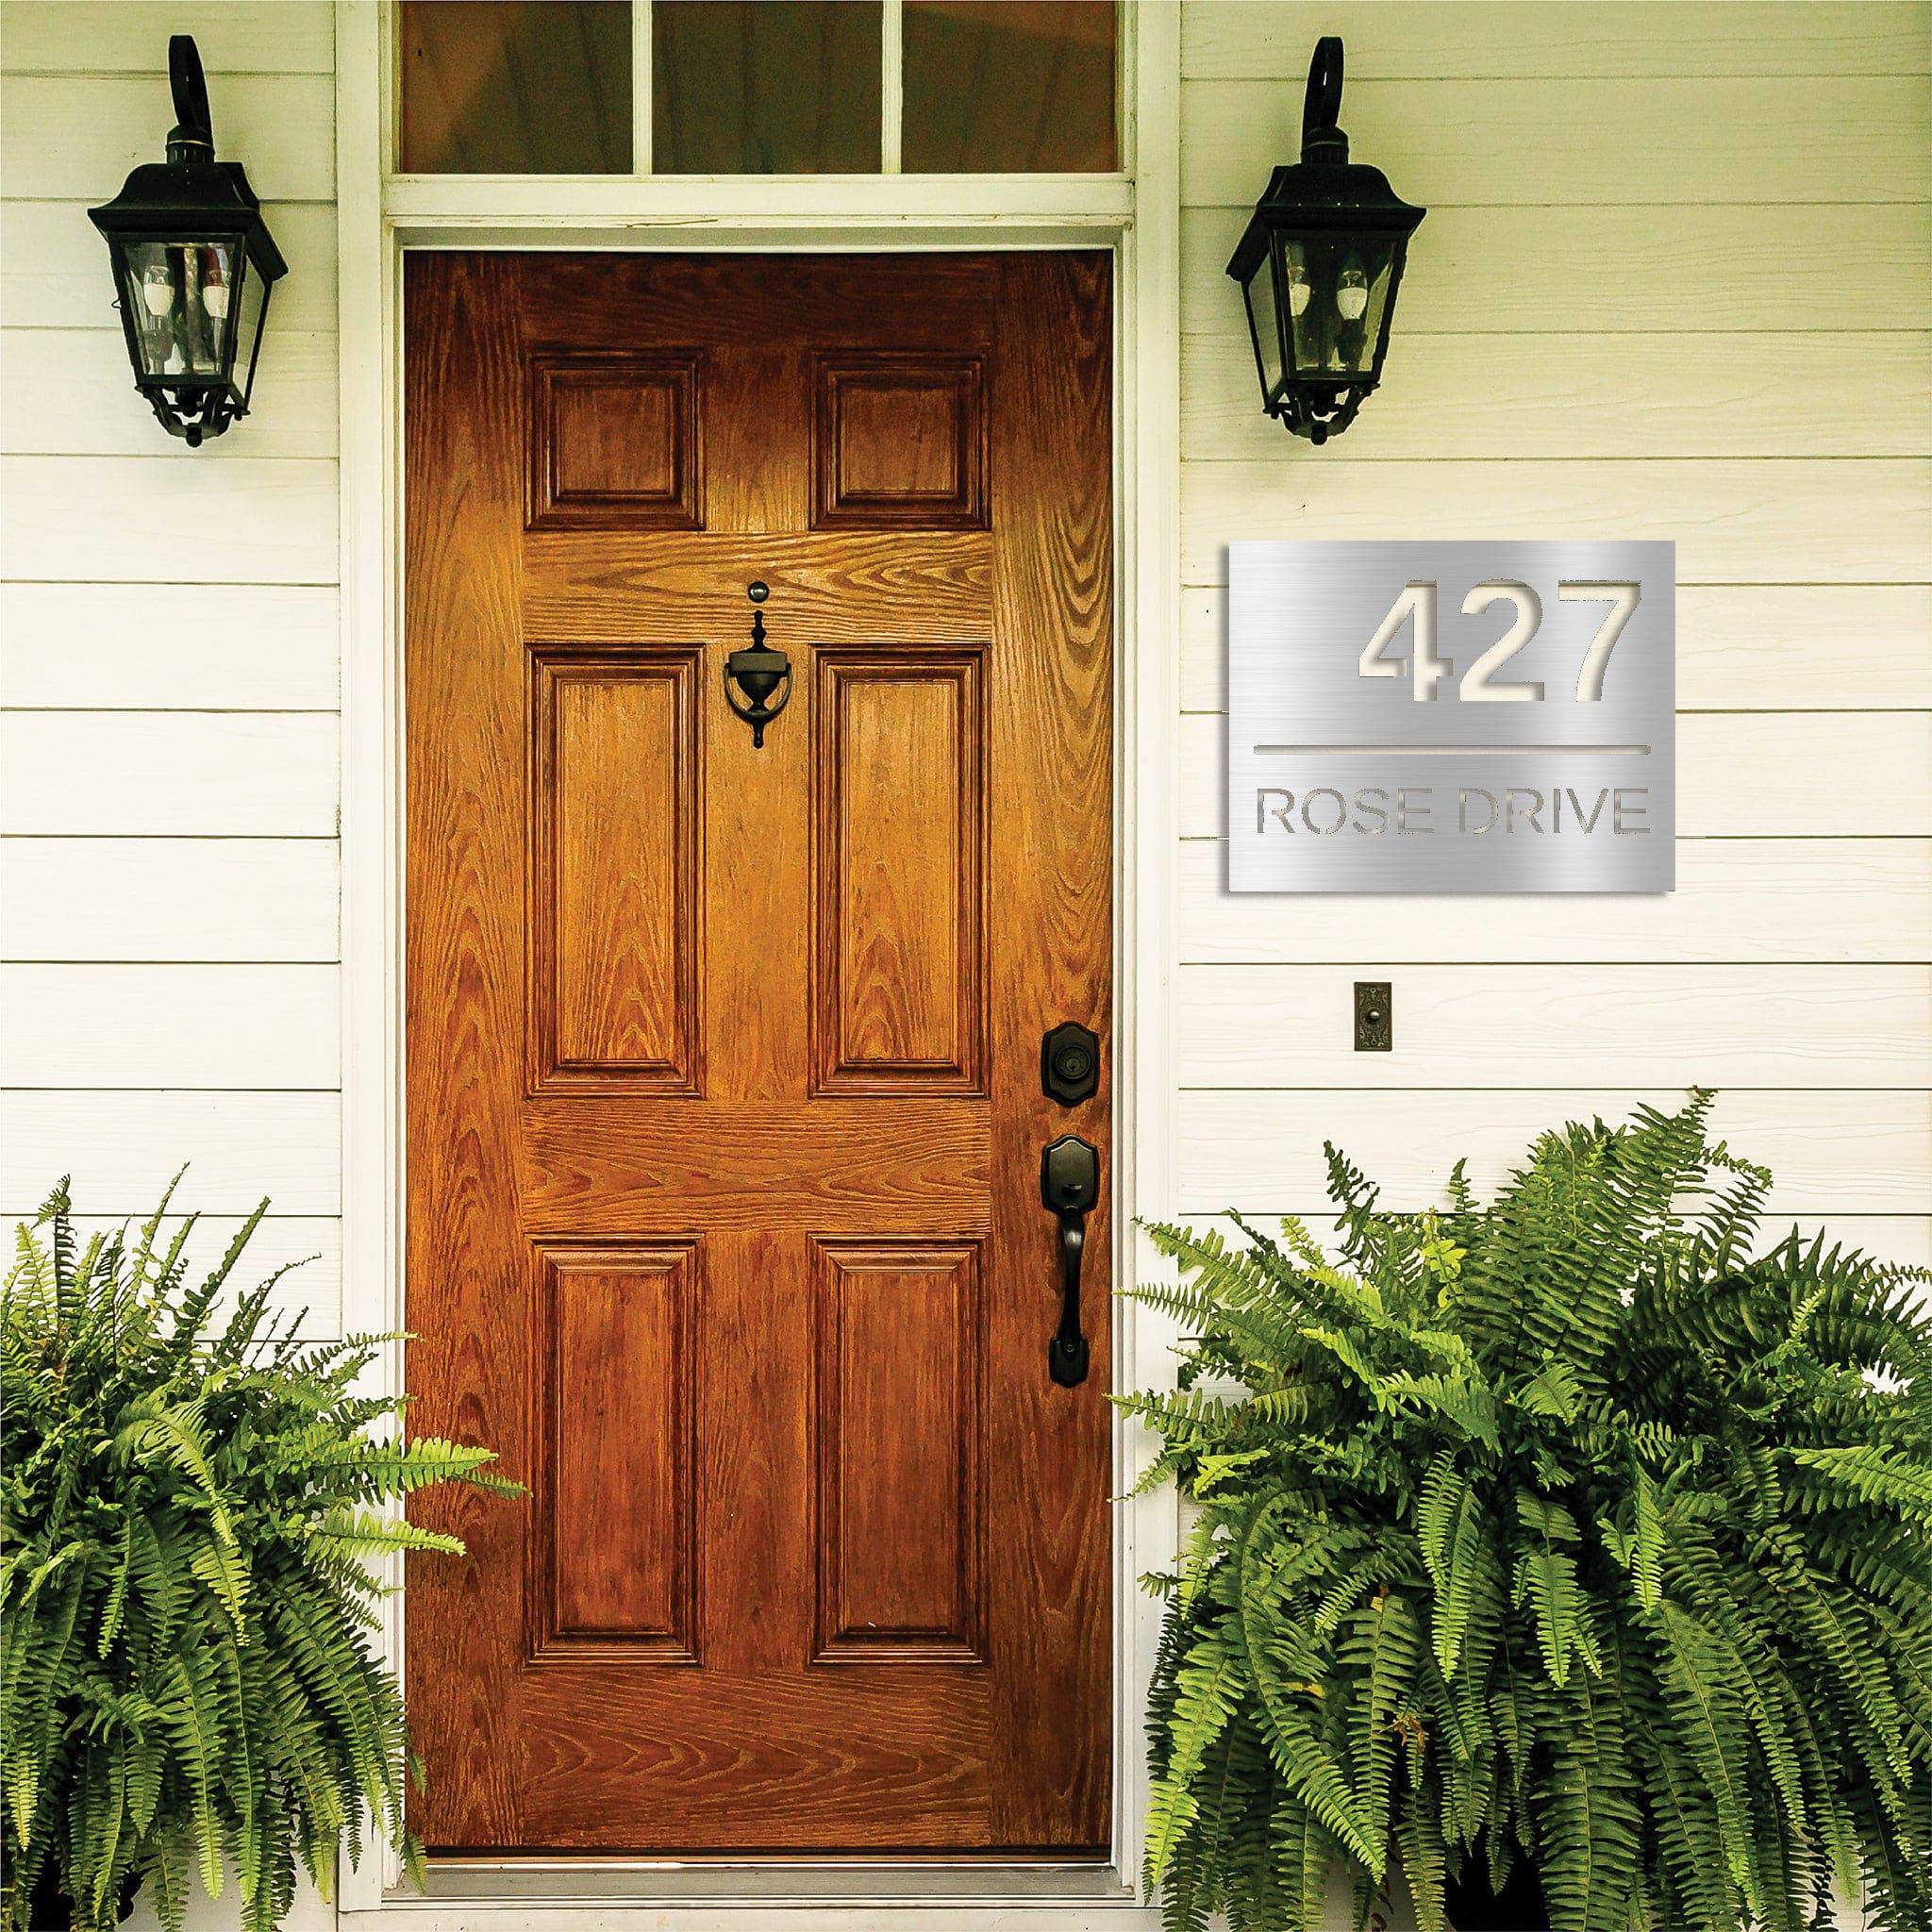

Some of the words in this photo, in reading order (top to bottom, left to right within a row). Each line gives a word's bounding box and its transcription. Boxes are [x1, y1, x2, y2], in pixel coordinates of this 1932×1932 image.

[1358, 578, 1641, 702] 427
[1257, 788, 1434, 834] ROSE
[1458, 788, 1651, 834] DRIVE
